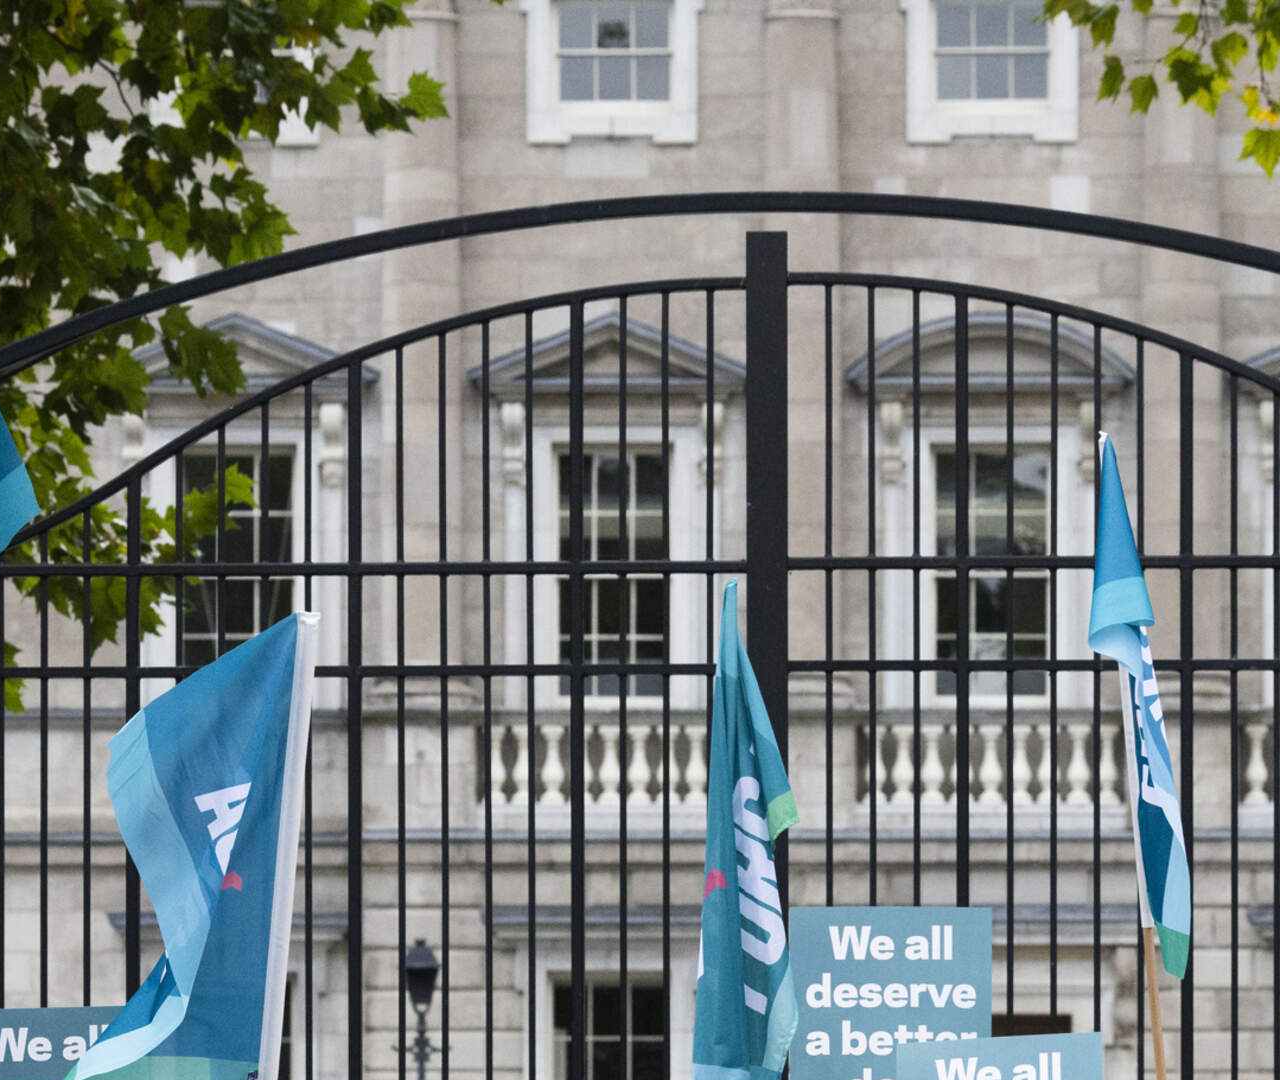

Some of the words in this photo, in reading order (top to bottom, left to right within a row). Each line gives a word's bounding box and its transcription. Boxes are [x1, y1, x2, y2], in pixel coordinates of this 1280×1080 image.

[828, 925, 895, 960] We
[904, 925, 953, 961] all
[805, 972, 977, 1008] deserve
[62, 1024, 109, 1061] al
[805, 1029, 830, 1056] a
